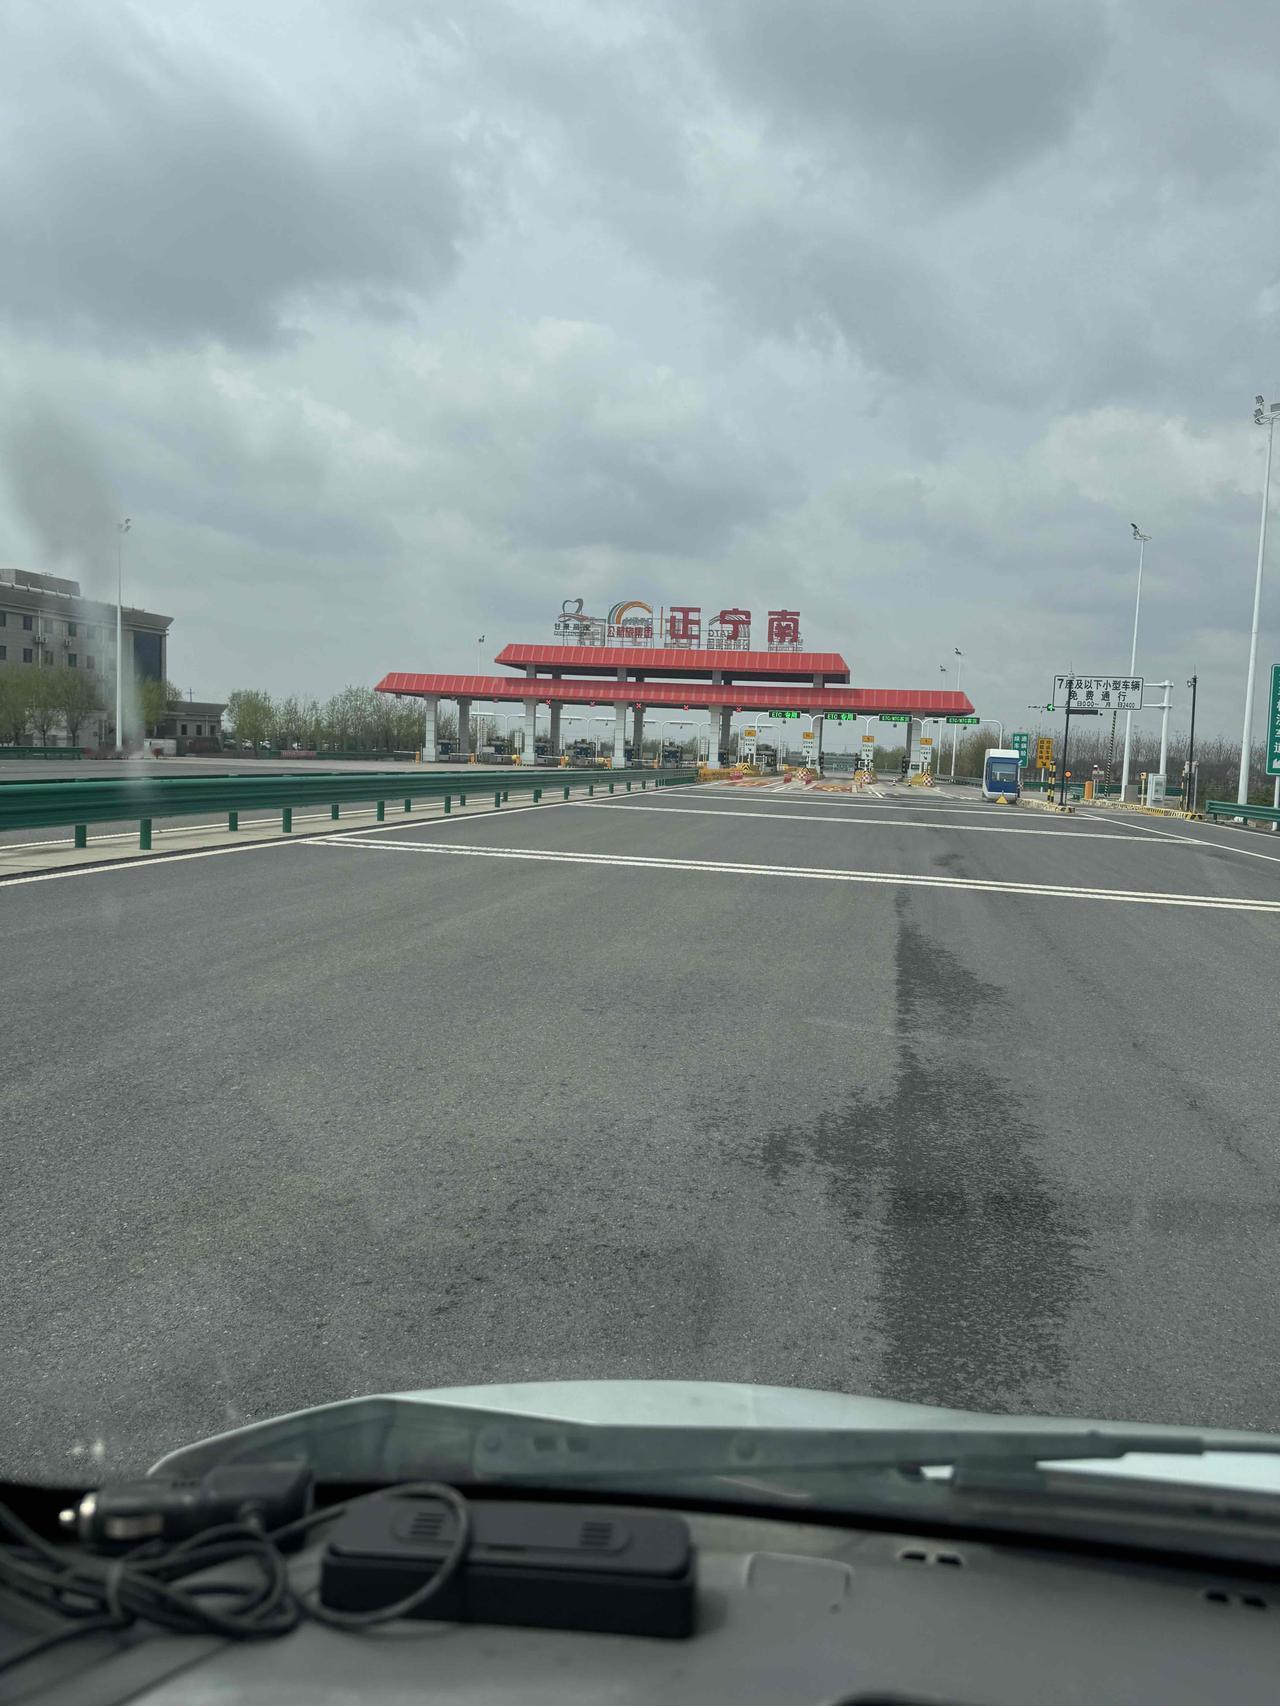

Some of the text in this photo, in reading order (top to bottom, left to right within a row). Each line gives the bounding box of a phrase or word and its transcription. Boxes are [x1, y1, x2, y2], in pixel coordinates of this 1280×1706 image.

[670, 607, 800, 643] 正宁南
[1069, 690, 1126, 702] 免费通行
